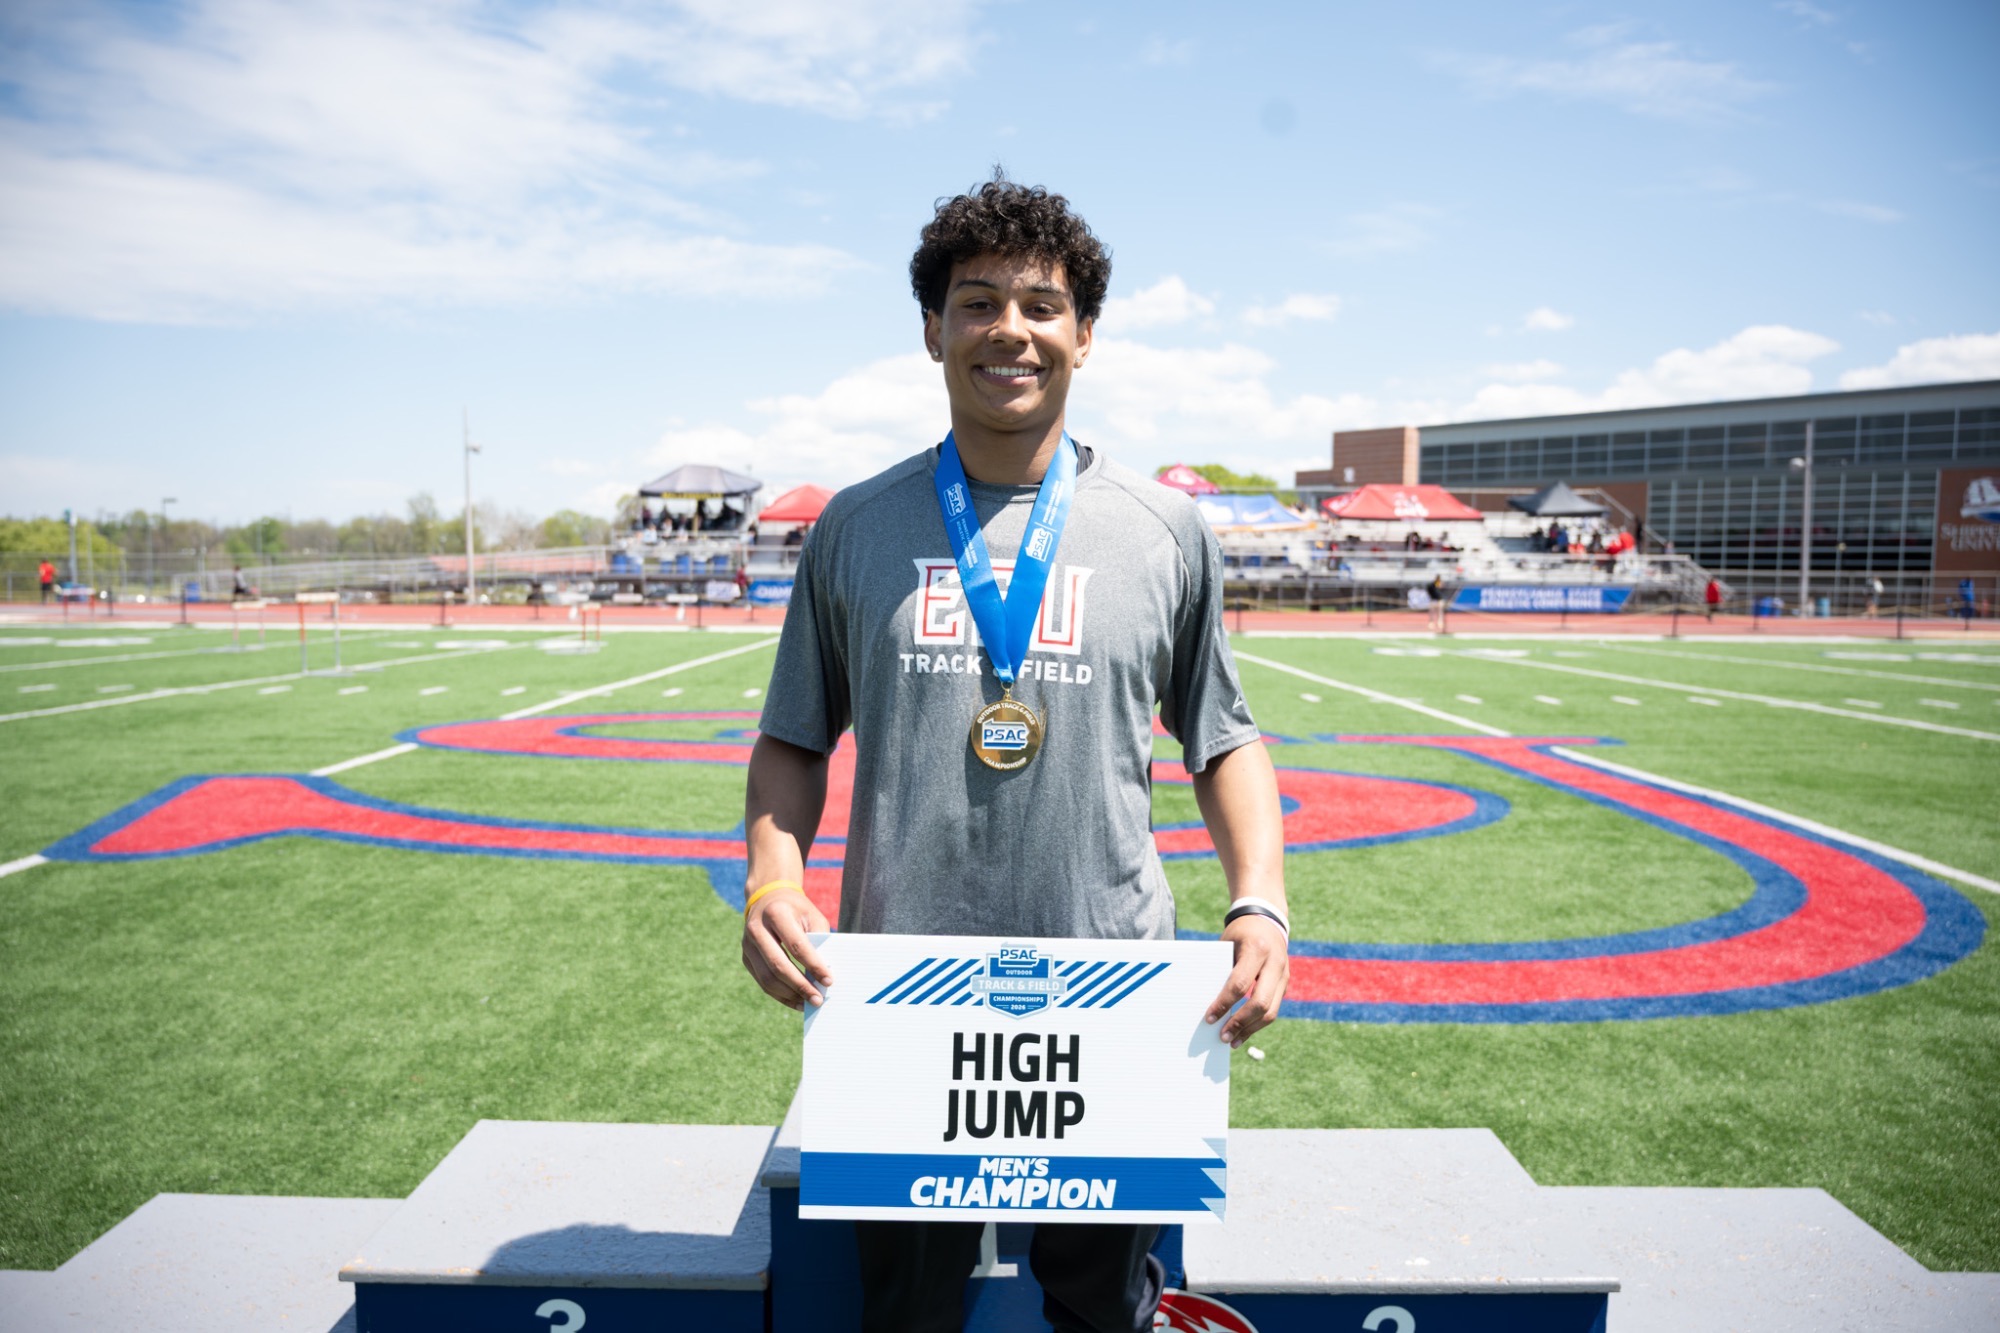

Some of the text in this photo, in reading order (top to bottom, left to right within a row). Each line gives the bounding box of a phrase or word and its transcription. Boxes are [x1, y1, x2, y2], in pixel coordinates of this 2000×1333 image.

[948, 486, 962, 514] PSAC
[1032, 531, 1047, 557] PSAC
[900, 653, 983, 675] TRACK
[1019, 659, 1092, 685] FIELD
[977, 703, 1000, 724] OUTDOOR
[1001, 702, 1019, 711] TRACK
[984, 729, 1026, 741] PSAC
[1000, 949, 1037, 960] PSAC
[978, 980, 1060, 991] TRACK & FIELD
[993, 995, 1044, 1003] CHAMPIONSHIPS
[952, 1032, 1080, 1082] HIGH
[943, 1089, 1085, 1142] JUMP
[978, 1157, 1050, 1177] MEN'S
[910, 1176, 1117, 1209] CHAMPION
